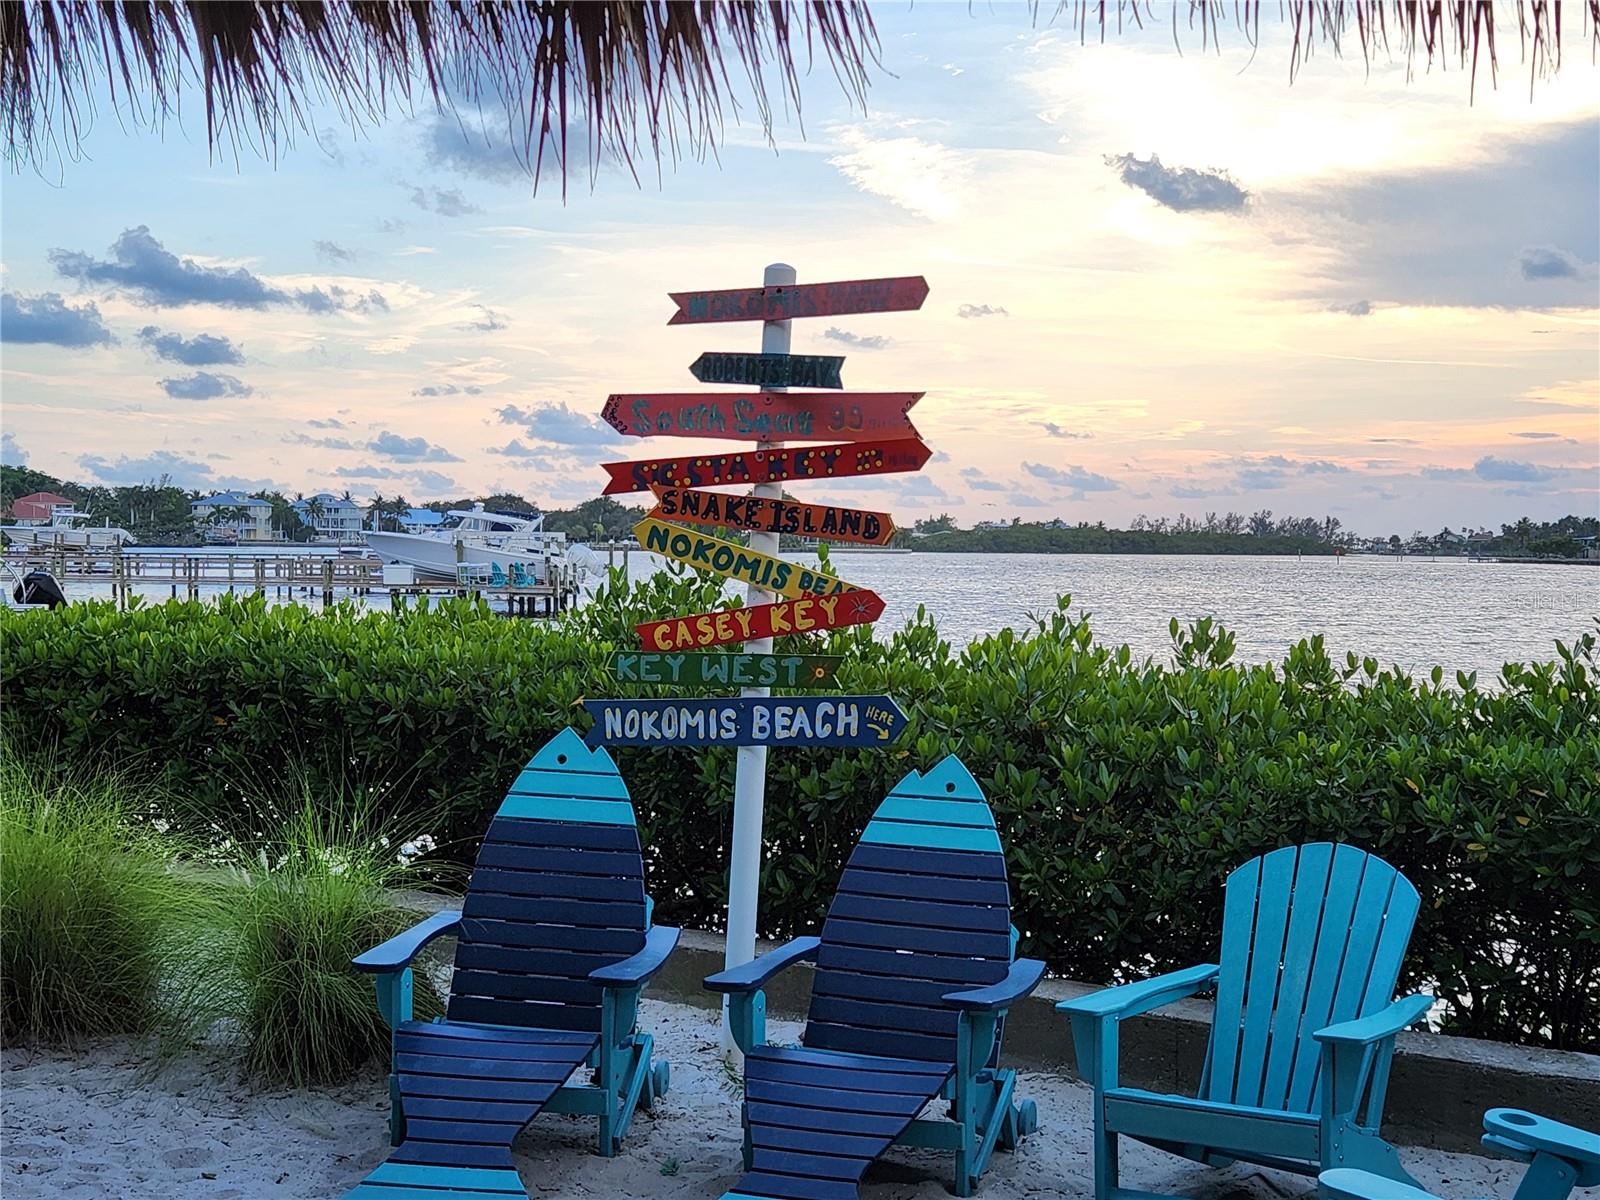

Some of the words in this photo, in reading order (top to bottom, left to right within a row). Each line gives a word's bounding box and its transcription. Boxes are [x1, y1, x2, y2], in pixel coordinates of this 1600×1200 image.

[631, 400, 725, 433] South
[632, 454, 751, 489] SIESTA
[768, 448, 841, 480] KEY
[661, 490, 762, 530] SNAKE
[766, 500, 881, 540] ISLAND
[646, 525, 793, 590] NOKOMIS
[799, 571, 857, 595] BEA
[653, 611, 753, 651] CASEY
[770, 596, 839, 634] KEY
[616, 654, 686, 682] KEY
[701, 655, 804, 686] WEST
[604, 706, 737, 740] NOKOMIS
[752, 702, 858, 740] BEACH
[865, 705, 895, 727] HERE
